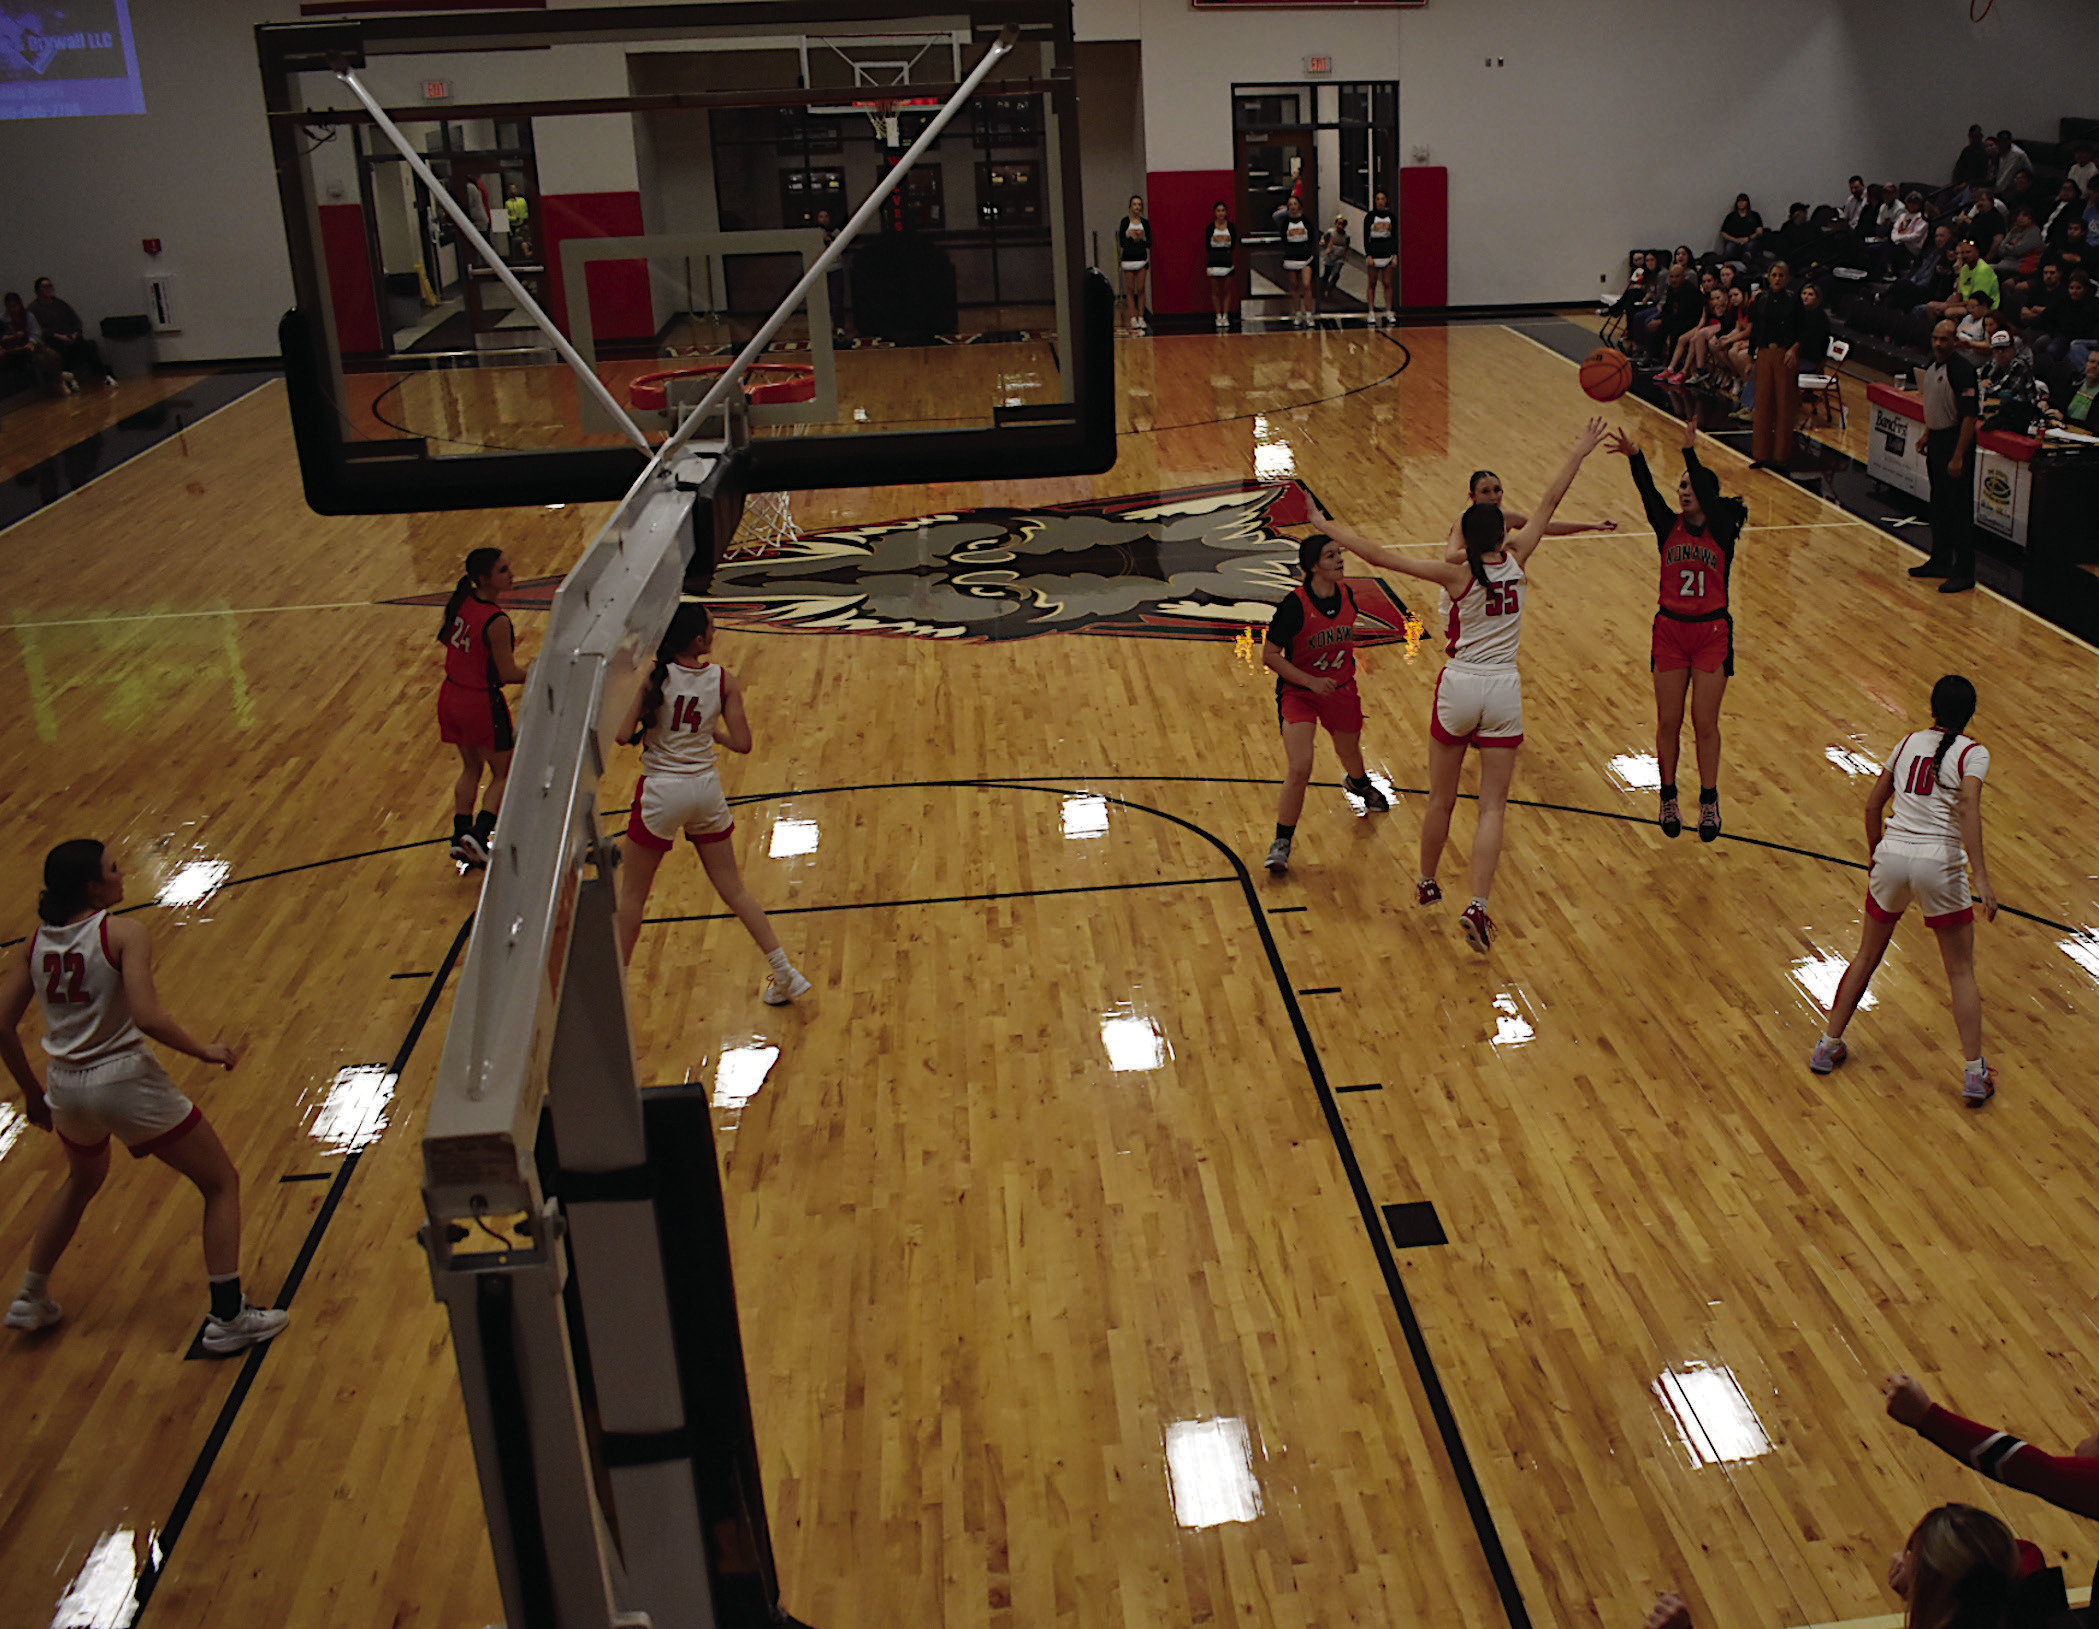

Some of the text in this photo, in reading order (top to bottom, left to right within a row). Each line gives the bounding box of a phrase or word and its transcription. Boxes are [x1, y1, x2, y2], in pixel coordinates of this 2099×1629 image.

[86, 31, 112, 49] LLC
[1311, 57, 1327, 71] EXIT
[427, 82, 444, 97] EXIT
[1665, 544, 1718, 572] KONAWA
[1679, 569, 1705, 597] 21
[1486, 579, 1519, 616] 55
[451, 616, 471, 653] 24
[1309, 626, 1353, 649] KONAW
[1312, 650, 1346, 671] 44
[671, 695, 702, 733] 14
[1904, 756, 1936, 795] 10
[43, 952, 91, 1003] 22
